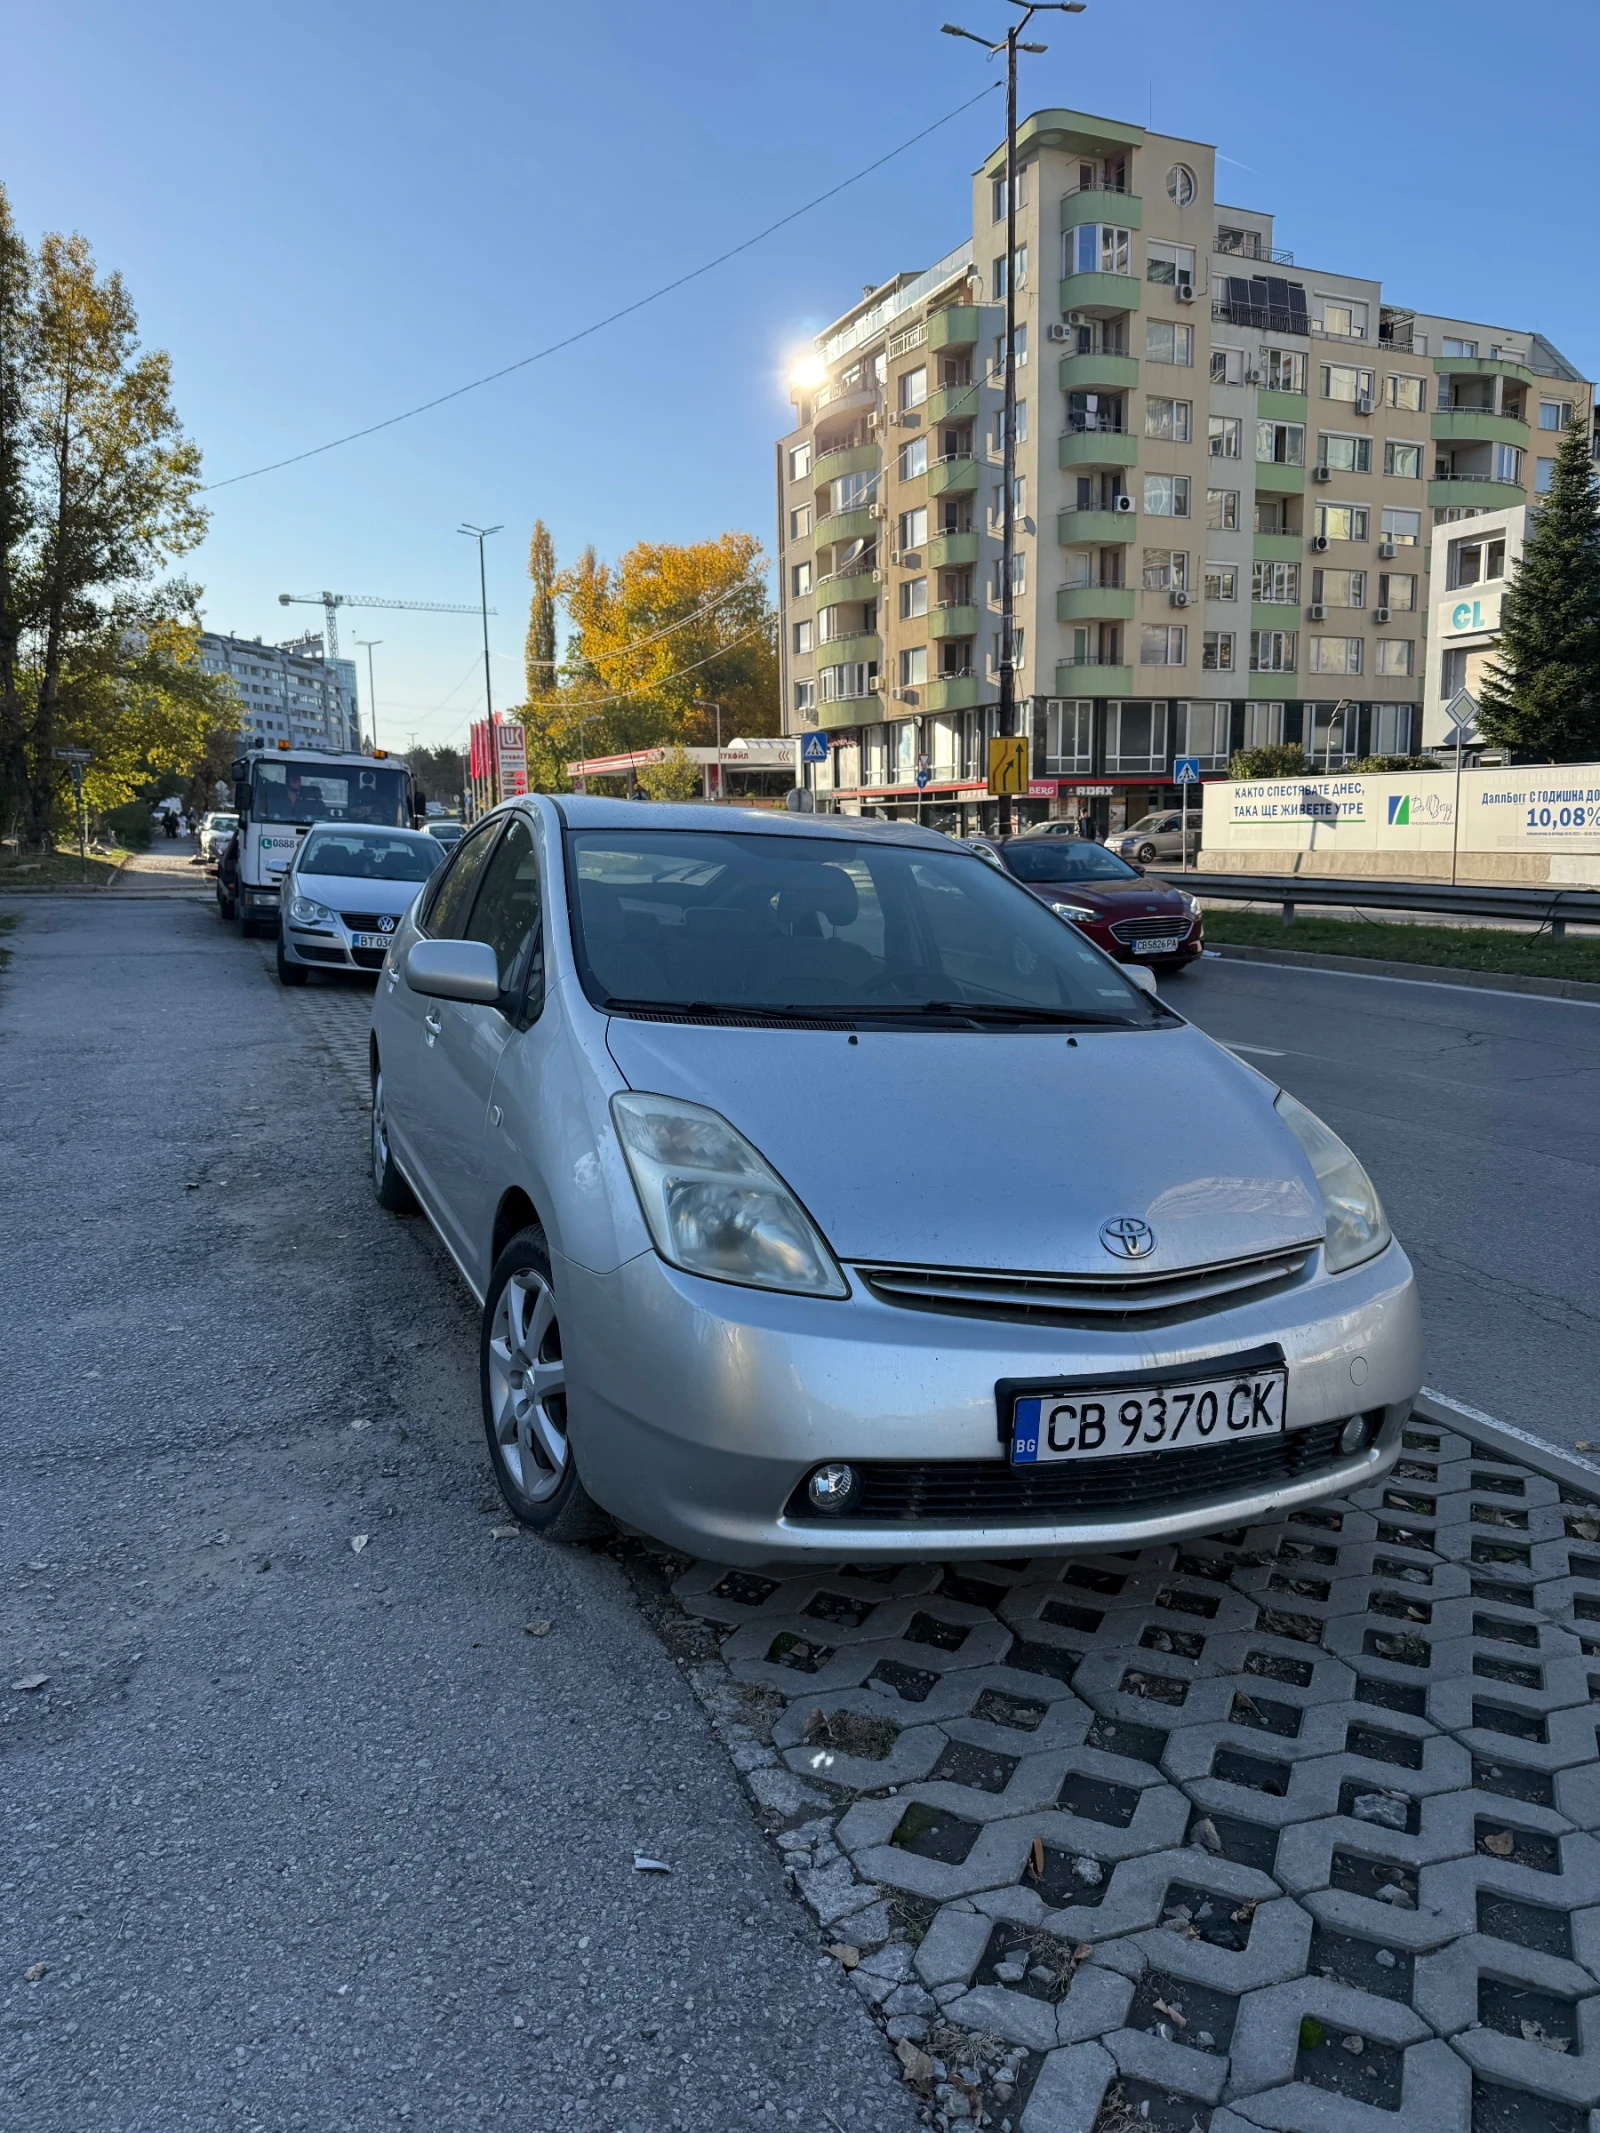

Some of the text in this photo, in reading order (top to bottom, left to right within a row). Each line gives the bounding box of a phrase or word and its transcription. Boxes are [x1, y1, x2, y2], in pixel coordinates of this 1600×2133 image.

[1076, 786, 1114, 795] ADAX
[1235, 783, 1365, 798] КАКТО СПЕСТЯВАТЕ ДНЕС,
[1538, 789, 1584, 804] ГОДИШНА
[1234, 803, 1363, 818] ТАКА ЩЕ ЖИВЕЕТЕ УТРЕ
[273, 839, 294, 848] 0888
[1047, 1380, 1276, 1452] CB 9370 CK
[1016, 1439, 1036, 1453] BG
